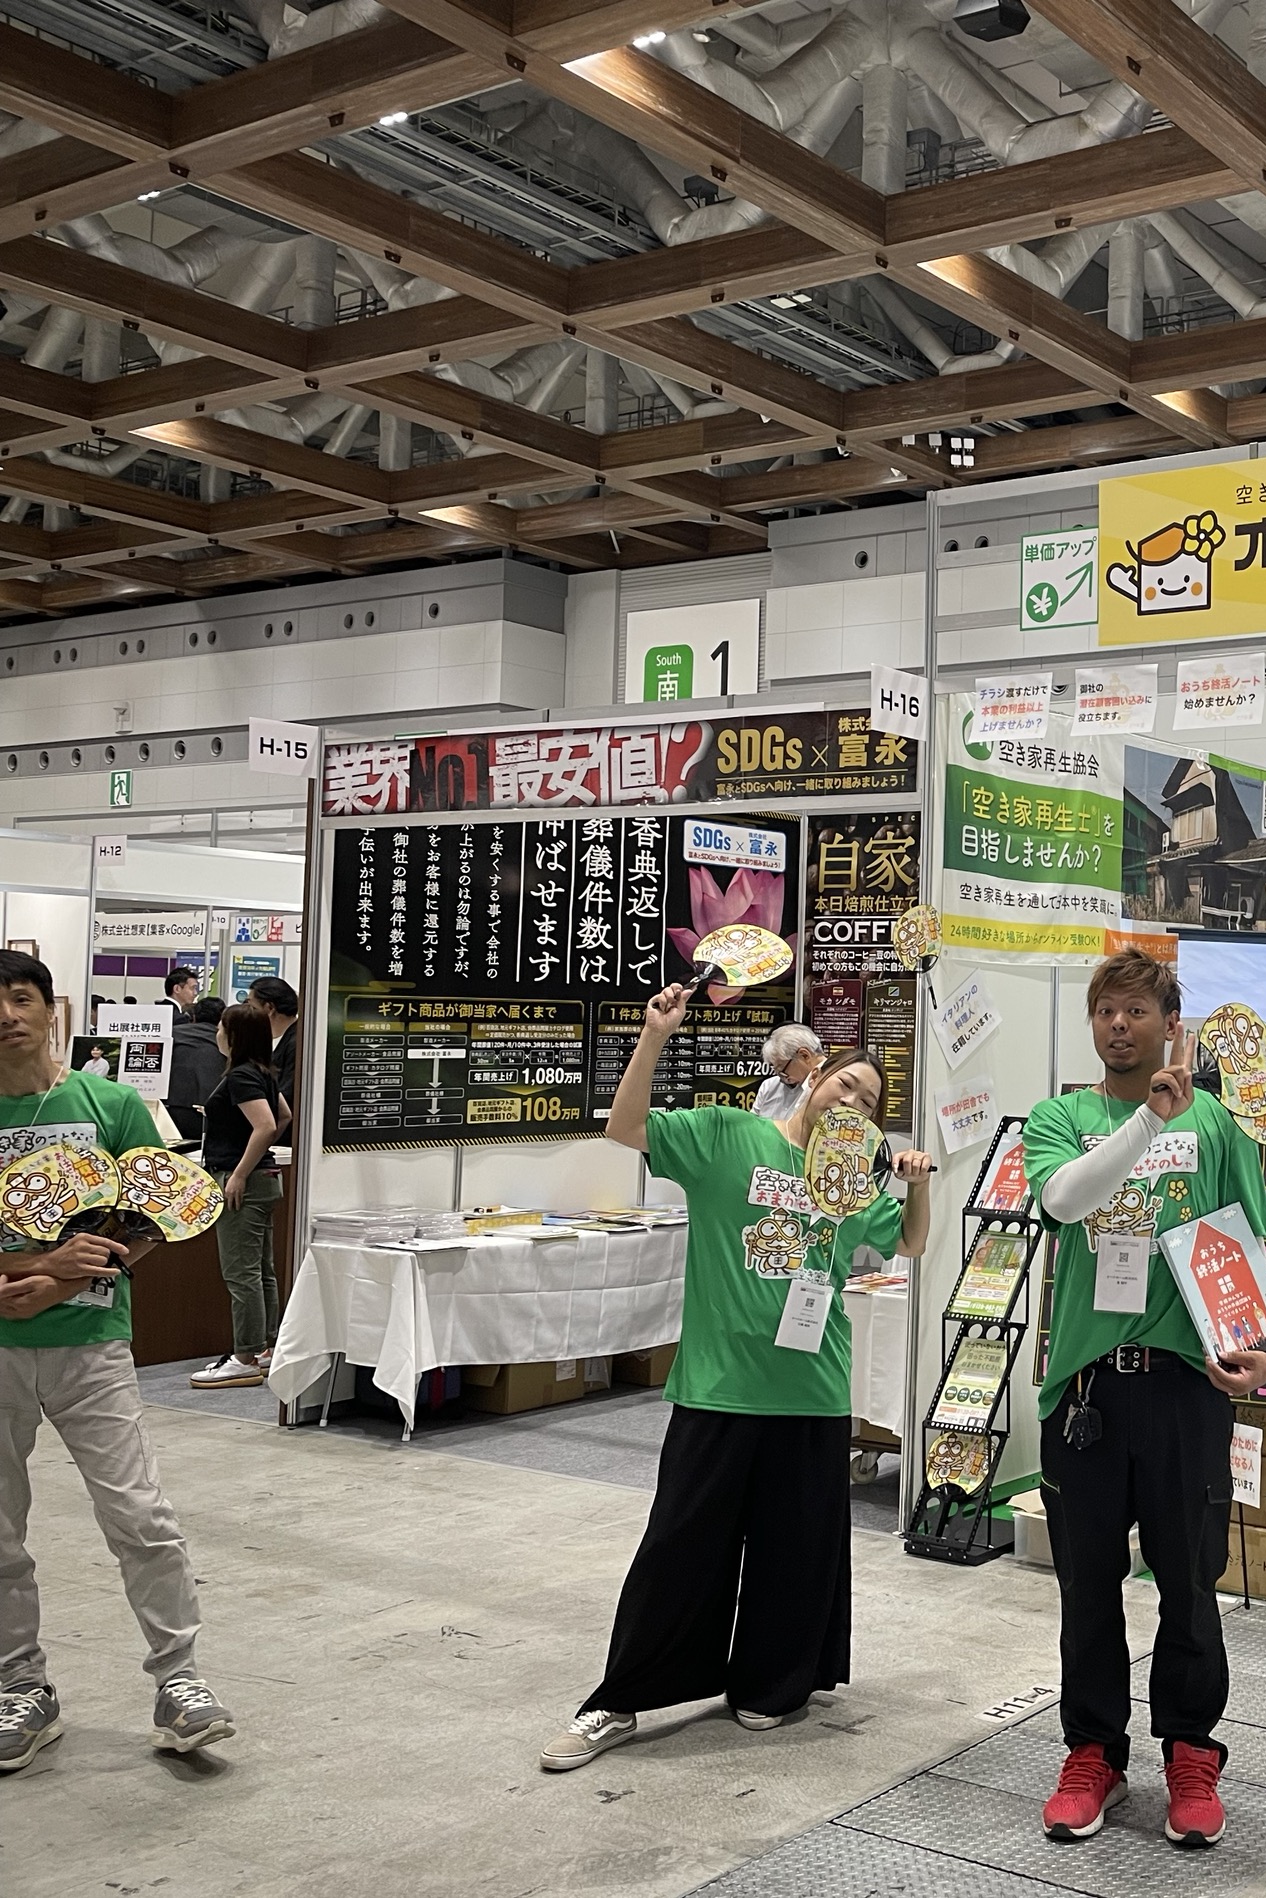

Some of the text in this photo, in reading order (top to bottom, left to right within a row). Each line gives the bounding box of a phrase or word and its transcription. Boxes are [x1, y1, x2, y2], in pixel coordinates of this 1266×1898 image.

[1025, 537, 1098, 563] 単価アップ
[655, 652, 682, 667] South
[709, 640, 730, 697] 1
[656, 669, 680, 701] 南
[980, 685, 1048, 700] チラシ渡すだけで
[1080, 683, 1104, 694] 御社の
[1181, 675, 1261, 693] おうち終活ノート
[880, 687, 920, 718] H-16
[981, 701, 1044, 716] 本業の利益以上
[1080, 695, 1152, 709] 潜在顧客囲い込みに
[1078, 711, 1122, 723] 役立ちます。
[259, 736, 308, 760] H-15
[717, 725, 803, 775] SDGs
[838, 732, 909, 768] 富永
[998, 738, 1100, 778] 空き家再生協会
[99, 845, 122, 857] H-12
[692, 825, 731, 851] SDGs
[749, 838, 778, 857] 富永
[818, 831, 917, 893] 自家
[486, 826, 504, 980] を安くする事で会社の
[575, 816, 614, 984] 葬儀件数は
[625, 816, 664, 986] 香典返しで
[814, 895, 918, 914] 本日焙煎仕立て
[814, 920, 896, 942] COFF
[812, 962, 911, 972] 初めての方もこの機会に自分
[378, 1001, 558, 1020] ギフト商品が御当家へ届くまで
[941, 984, 979, 1024] イタリアンの
[108, 1022, 162, 1033] 出展社専用
[954, 1007, 976, 1031] 料理人
[951, 1012, 993, 1054] 在籍しています。
[474, 1072, 514, 1082] 年間売上げ
[521, 1067, 583, 1085] 1,080万円
[698, 1064, 731, 1073] 年間売上げ
[522, 1097, 581, 1121] 108万円
[941, 1091, 990, 1118] 場所が田舎でも
[951, 1109, 989, 1133] 大丈夫です。
[1199, 1240, 1226, 1260] おうち
[1195, 1250, 1242, 1279] 終活ノート
[983, 1686, 1056, 1719] H11-4
